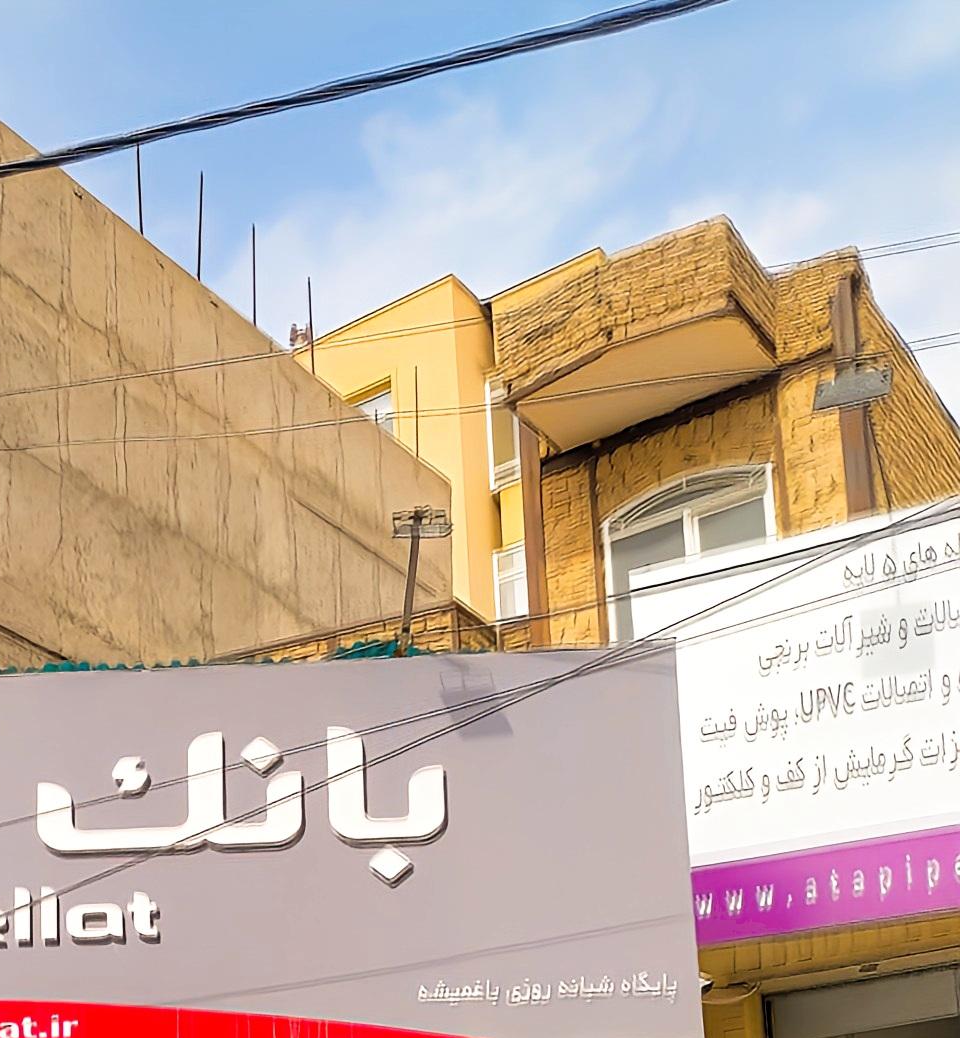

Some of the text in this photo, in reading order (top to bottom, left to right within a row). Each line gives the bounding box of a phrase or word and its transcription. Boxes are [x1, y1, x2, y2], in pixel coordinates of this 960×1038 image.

[758, 637, 810, 672] برنجی
[861, 668, 932, 706] اتصالات
[695, 766, 755, 811] کلکتور
[776, 756, 806, 788] کف
[812, 753, 827, 790] از
[36, 725, 449, 888] بانک
[416, 970, 679, 1007] پایگاه شبانه روزی باغمیشه
